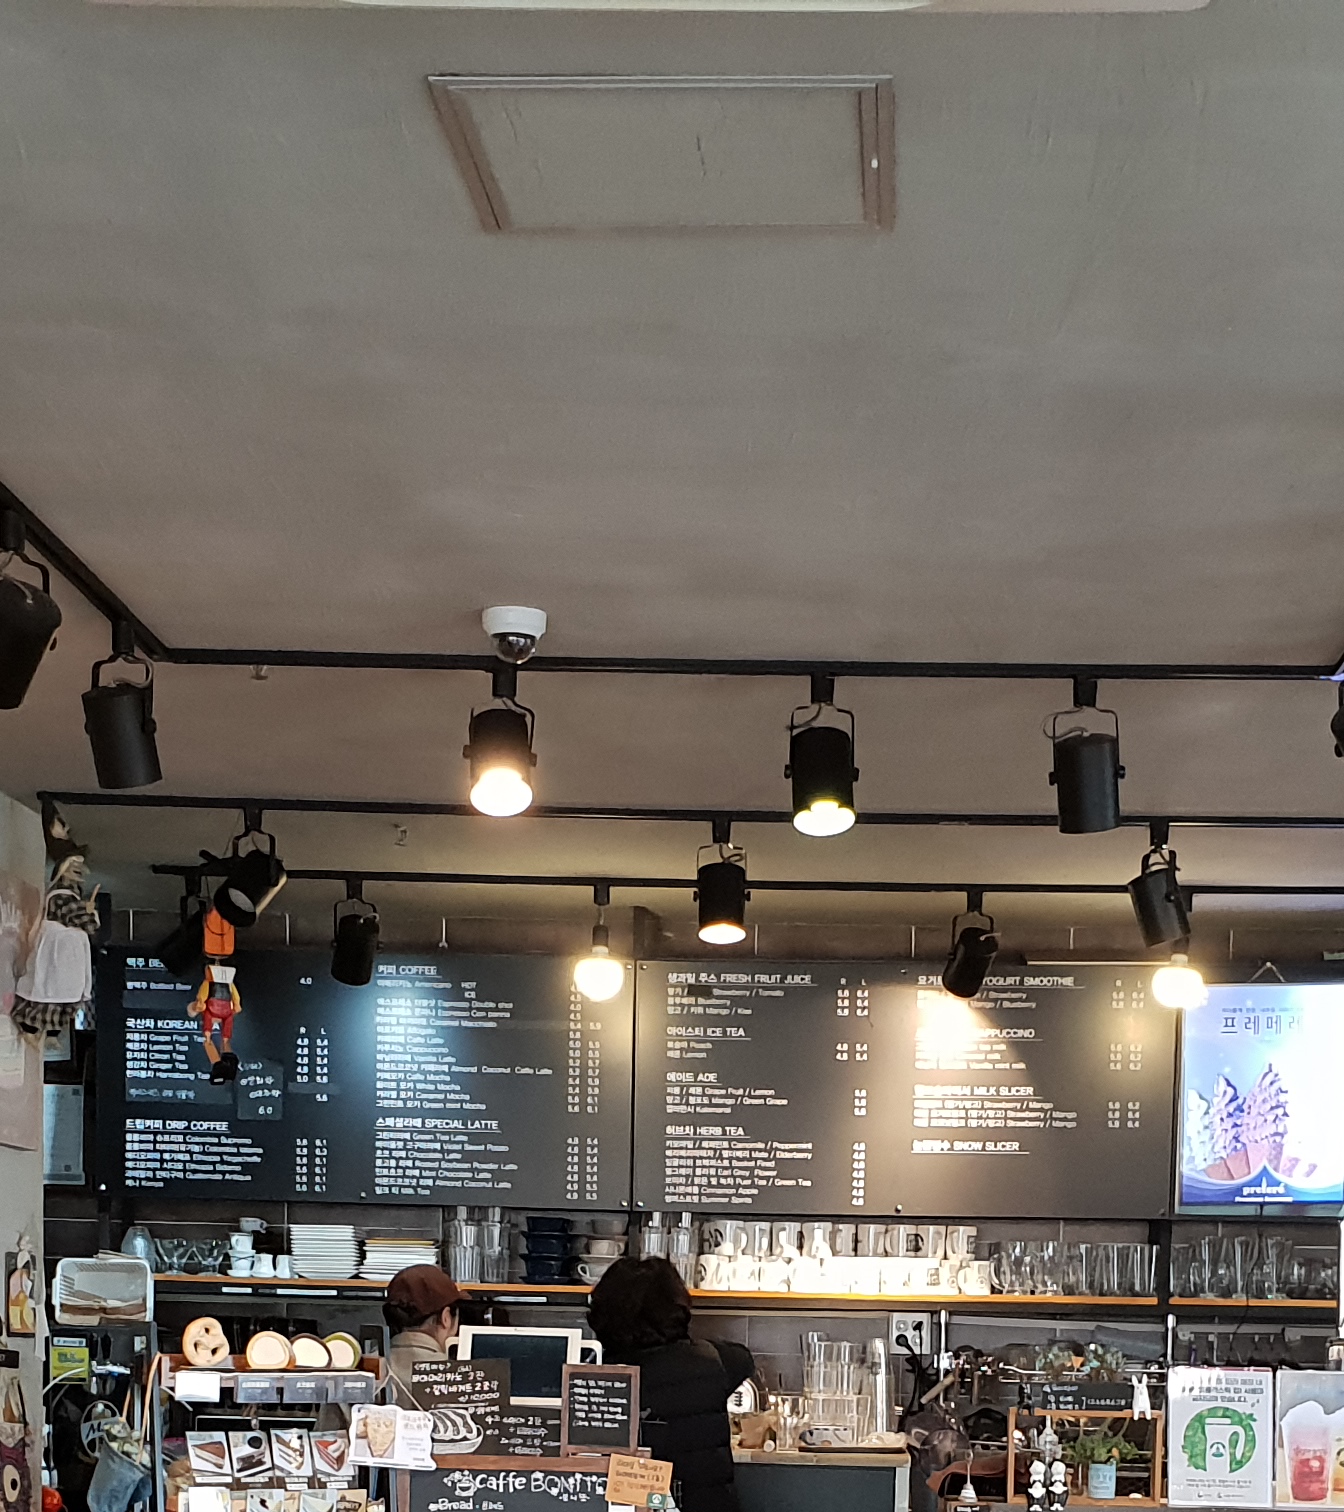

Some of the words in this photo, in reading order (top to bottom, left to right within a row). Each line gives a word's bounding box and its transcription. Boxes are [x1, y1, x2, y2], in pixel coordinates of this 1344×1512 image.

[399, 966, 438, 975] COFFEE
[720, 974, 752, 983] FRESH
[754, 974, 781, 984] FRUIT
[784, 975, 812, 984] JUICE
[982, 976, 1020, 986] YOGURT
[1023, 977, 1074, 986] SMOOTHIE
[126, 1018, 154, 1029] 국산차
[157, 1019, 198, 1030] KOREAN
[666, 1027, 703, 1036] 아이스티
[707, 1028, 723, 1036] ICE
[726, 1028, 745, 1037] TEA
[666, 1073, 694, 1082] 에이드
[697, 1073, 718, 1082] ADE
[973, 1086, 997, 1096] MILK
[999, 1087, 1034, 1096] SLICER
[166, 1121, 188, 1130] DRIP
[190, 1121, 229, 1131] COFFEE
[425, 1119, 465, 1129] SPECIAL
[468, 1120, 499, 1129] LATTE
[665, 1125, 694, 1136] 허브차
[697, 1126, 722, 1135] HERB
[725, 1126, 744, 1136] TEA
[985, 1141, 1020, 1151] SLICER
[530, 1471, 609, 1496] BONITO
